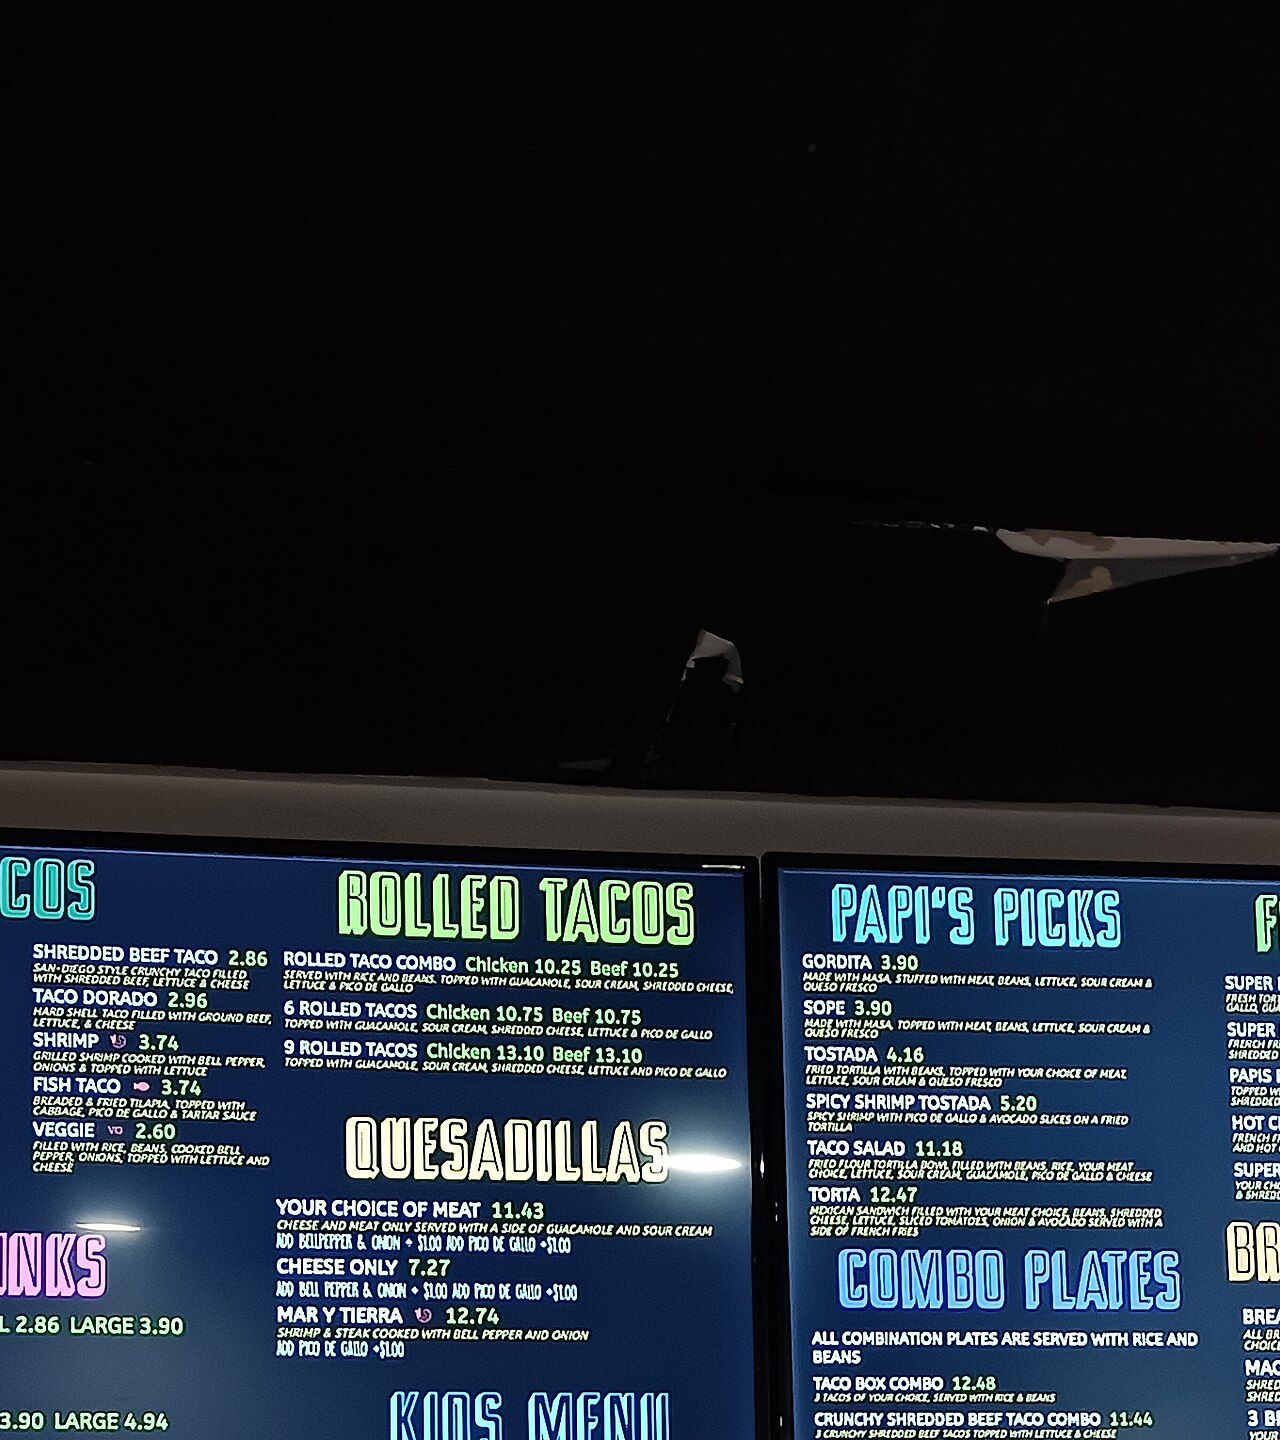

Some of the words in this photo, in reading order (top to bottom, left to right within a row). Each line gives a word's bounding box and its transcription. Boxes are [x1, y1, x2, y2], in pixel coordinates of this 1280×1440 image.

[339, 870, 519, 939] ROLLED
[539, 878, 694, 945] TACOS
[832, 884, 974, 945] PAPI'S
[994, 888, 1121, 947] PICKS
[33, 944, 124, 961] SHREDDED
[130, 947, 170, 963] BEEF
[173, 949, 218, 965] TACO
[229, 950, 267, 966] 2.86
[284, 951, 345, 967] ROLLED
[350, 953, 392, 969] TACO
[396, 955, 456, 971] COMBO
[466, 956, 528, 973] Chicken
[535, 959, 581, 975] 10.25
[591, 961, 628, 976] Beef
[633, 962, 678, 978] 10.25
[803, 954, 872, 969] GORDITA
[881, 955, 918, 970] 3.90
[1225, 976, 1273, 991] SUPER
[345, 1117, 669, 1182] QUESADILLAS
[276, 1199, 327, 1216] YOUR
[332, 1200, 398, 1217] CHOICE
[403, 1201, 428, 1217] OF
[433, 1202, 481, 1218] MEAT
[492, 1202, 543, 1219] 11.43
[839, 1249, 1004, 1309] COMBO
[1025, 1250, 1180, 1309] PLATES
[16, 1316, 59, 1333] 2.86
[71, 1317, 134, 1334] LARGE
[140, 1317, 183, 1335] 3.90
